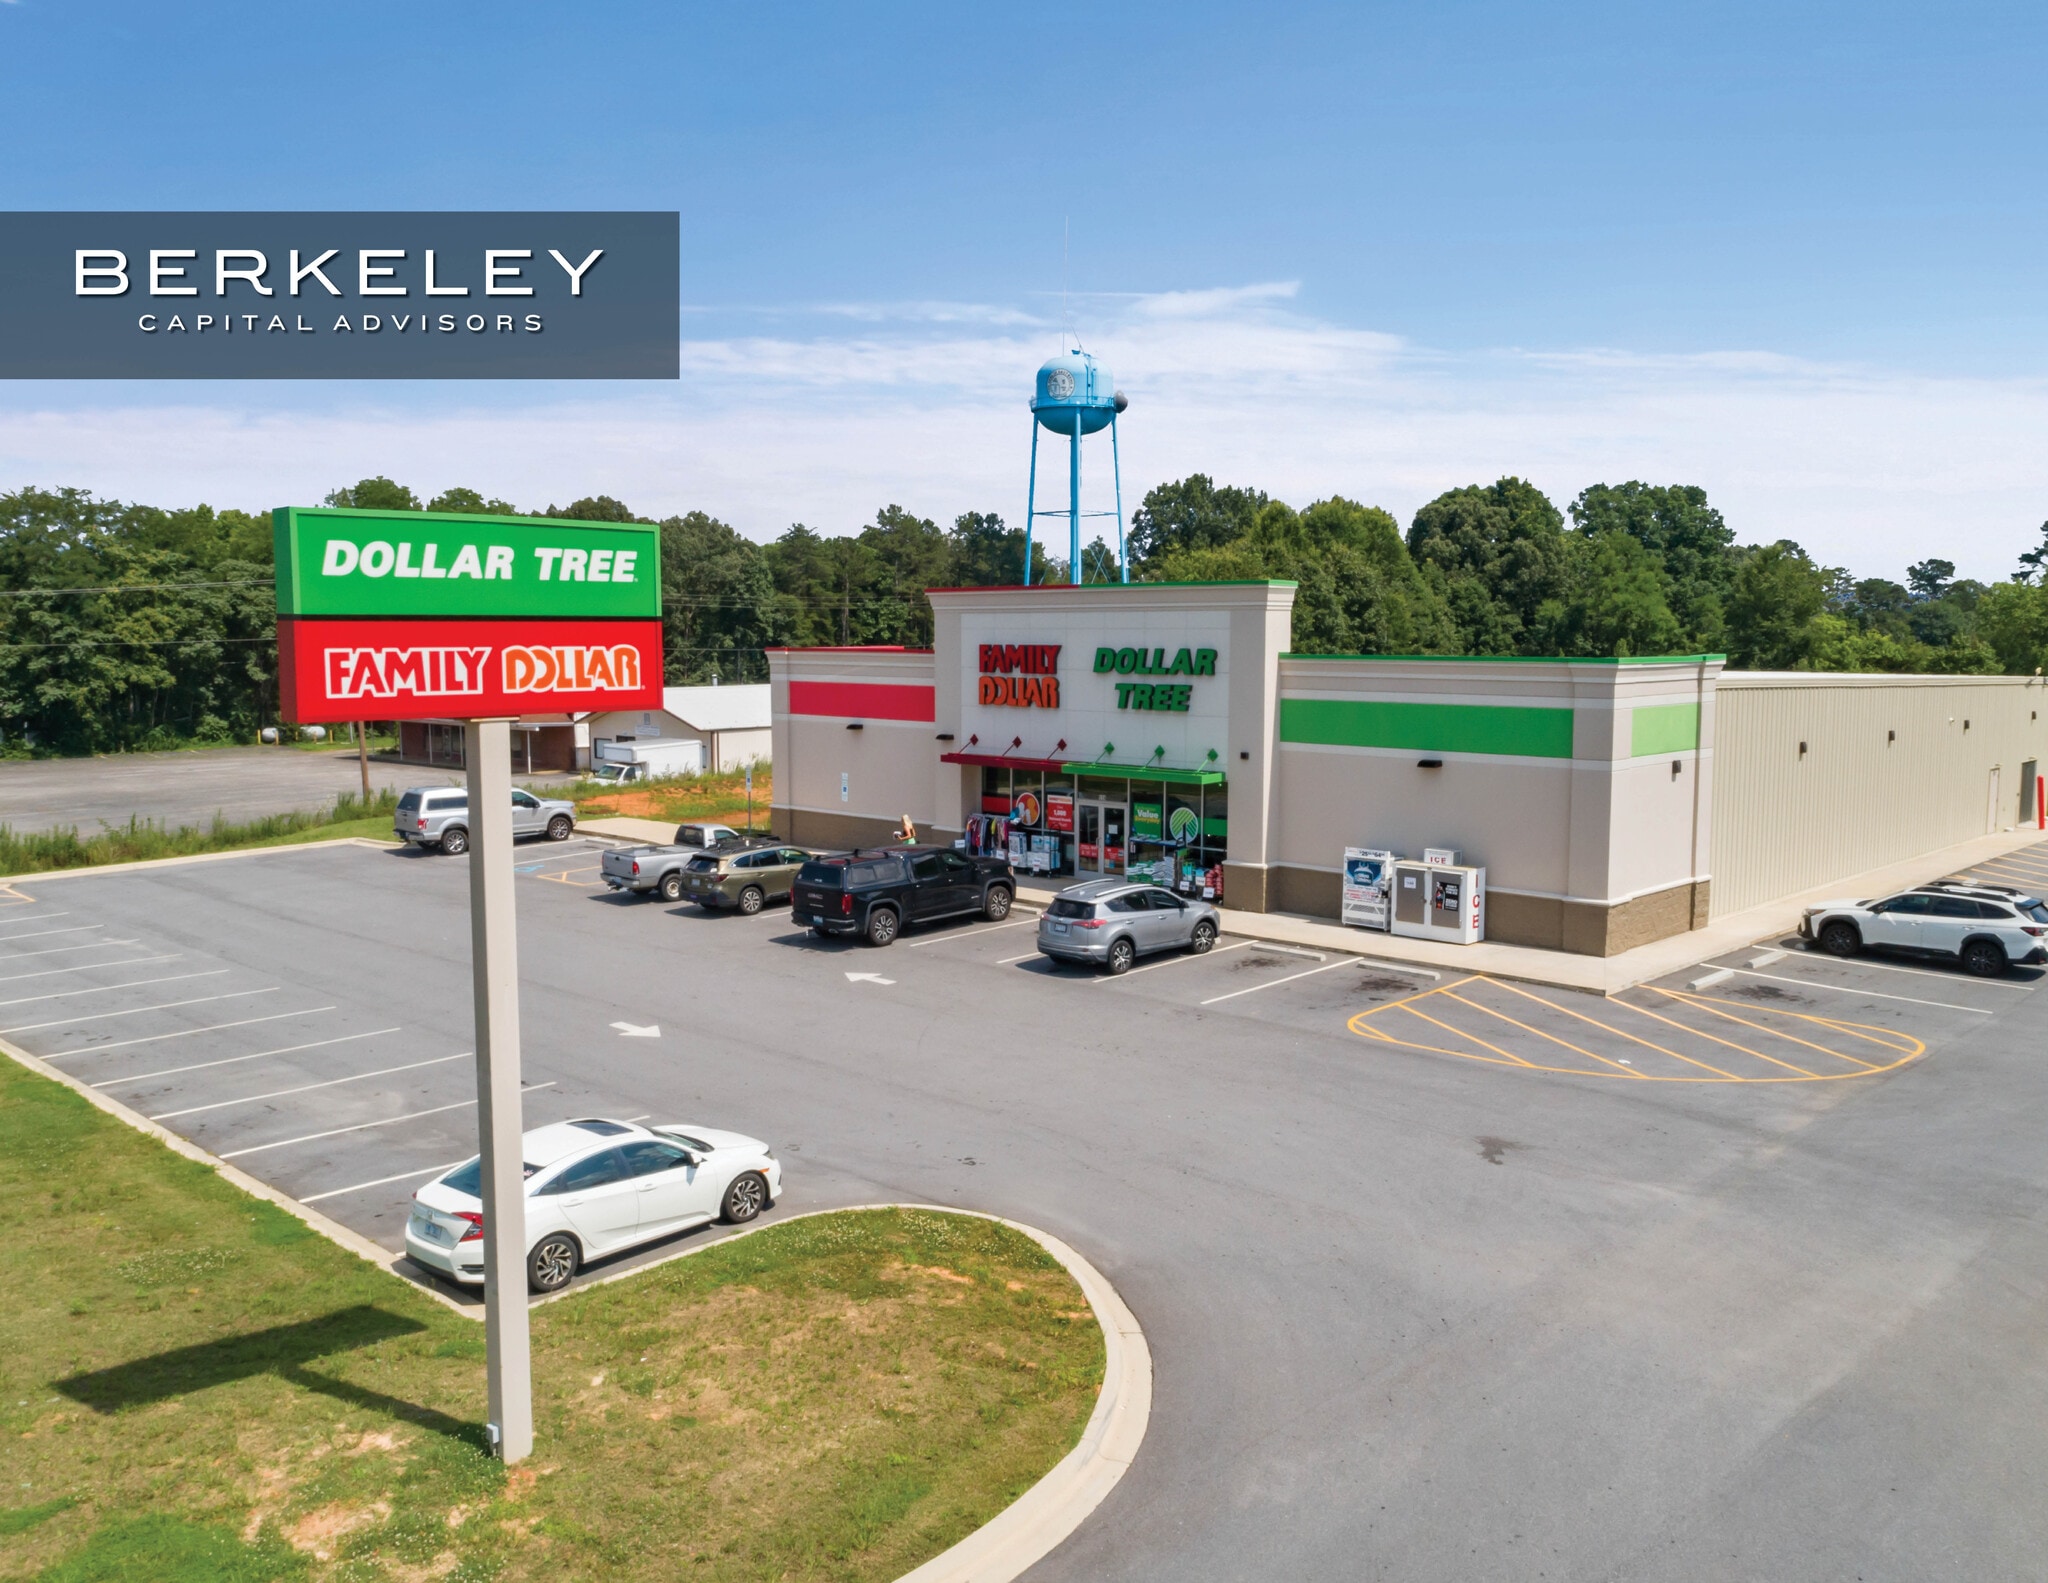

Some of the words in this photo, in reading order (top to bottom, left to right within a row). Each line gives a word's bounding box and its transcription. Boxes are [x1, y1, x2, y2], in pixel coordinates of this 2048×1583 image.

[322, 539, 515, 580] DOLLAR
[534, 547, 637, 583] TREE
[324, 646, 492, 699] FAMILY
[501, 643, 642, 694] DOLLAR
[979, 644, 1062, 674] FAMILY
[1093, 647, 1218, 676] DOLLAR
[978, 676, 1060, 709] DOLLAR
[1115, 683, 1193, 712] TREE
[1137, 809, 1159, 819] Value
[1429, 856, 1447, 865] ICE
[1472, 874, 1481, 929] ICE
